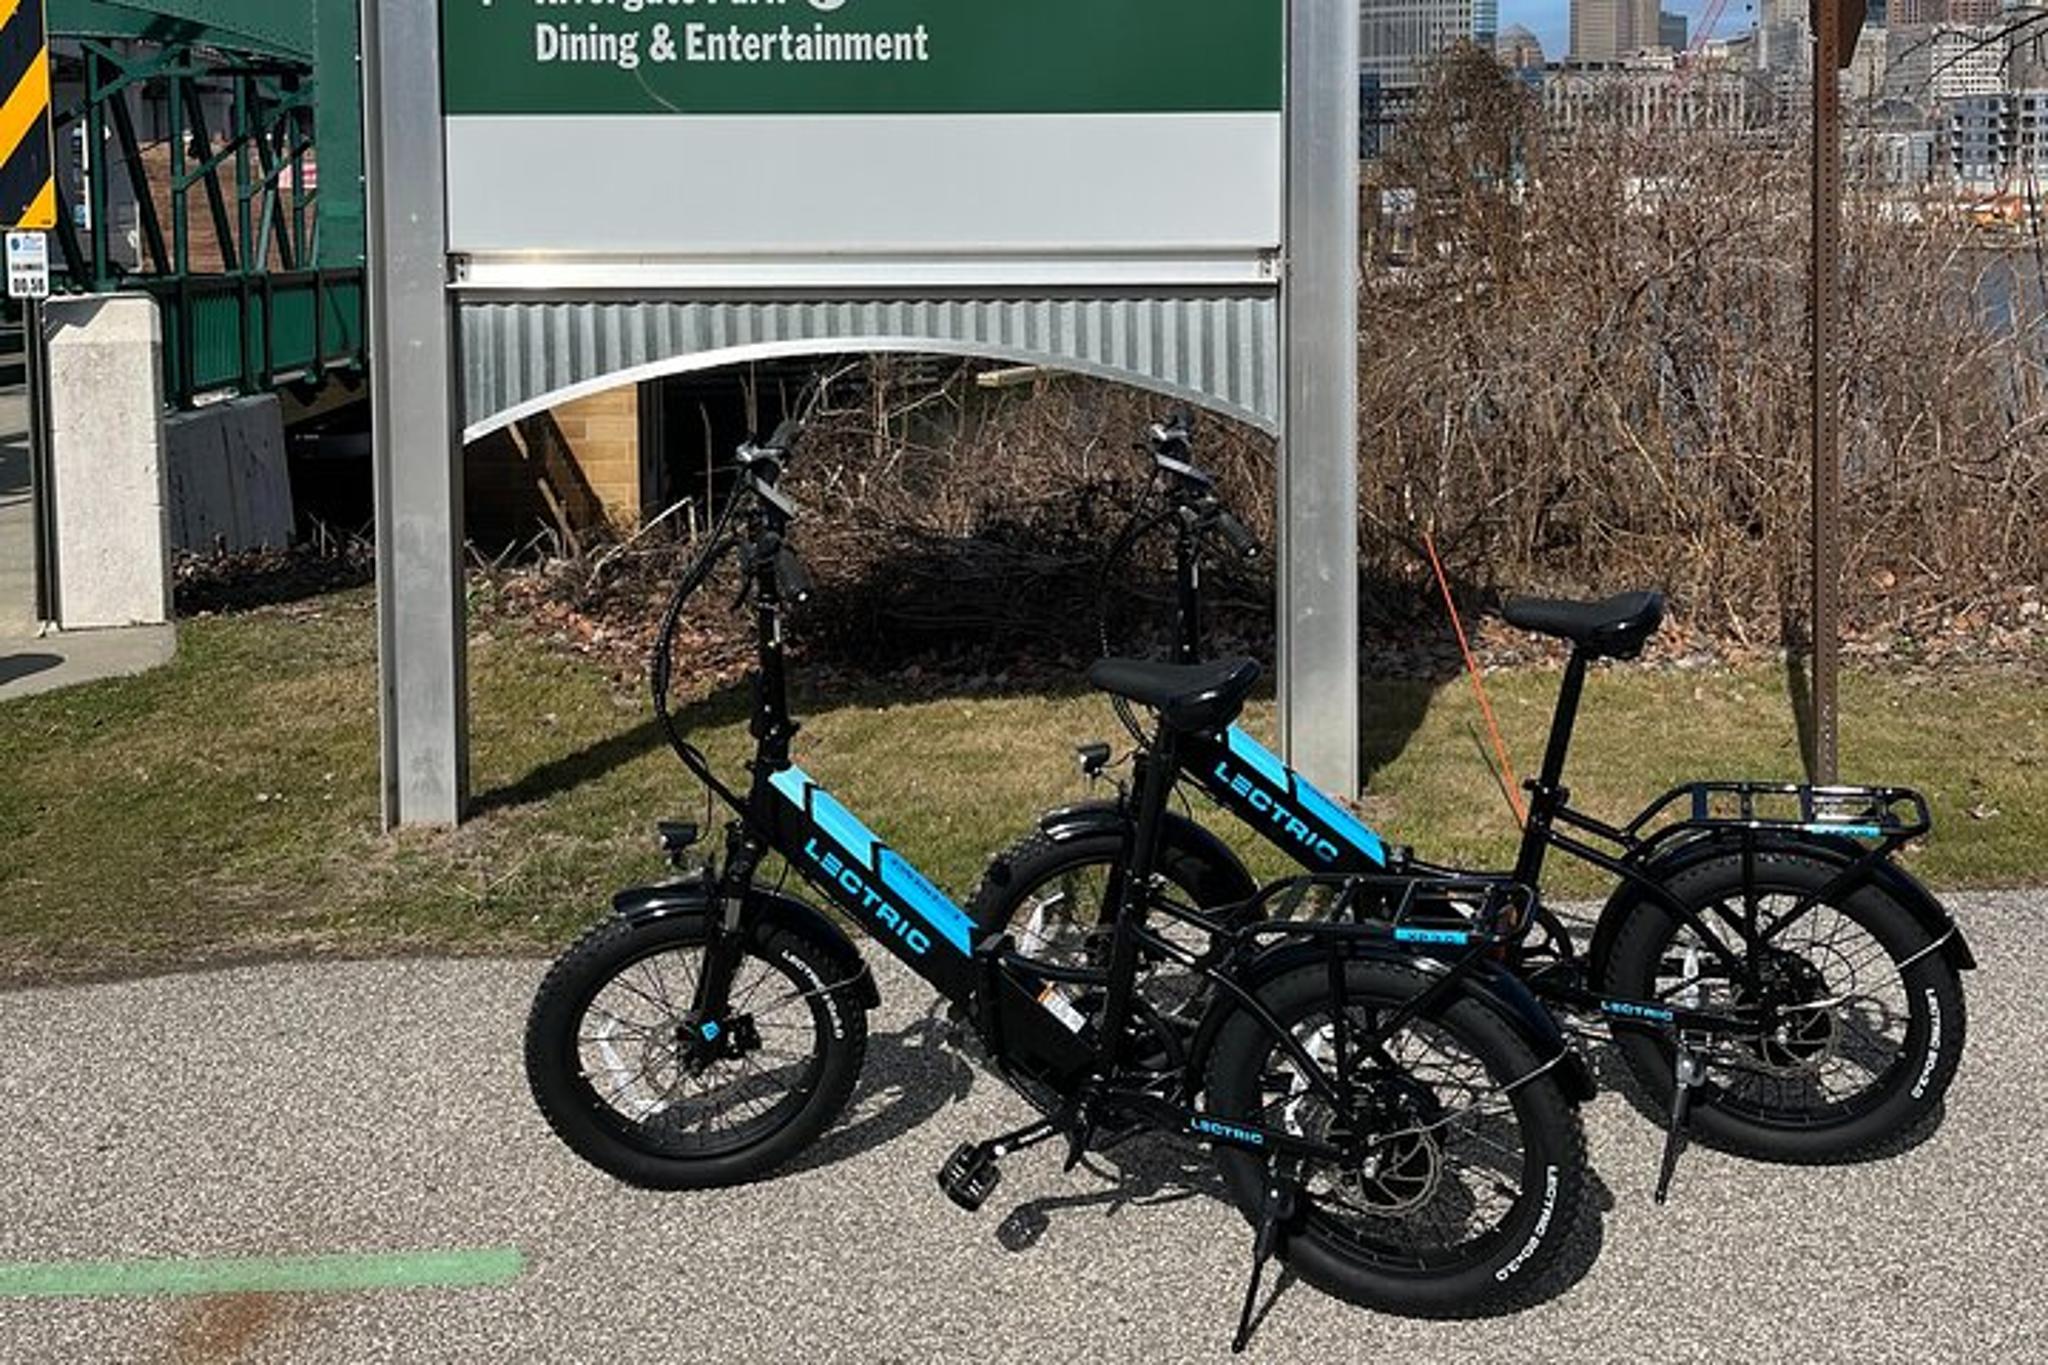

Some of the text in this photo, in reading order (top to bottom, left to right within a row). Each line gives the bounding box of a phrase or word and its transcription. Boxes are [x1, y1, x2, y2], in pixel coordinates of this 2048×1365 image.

[536, 22, 929, 69] Dining & Entertainment
[1214, 761, 1338, 863] LECTRIC
[804, 838, 931, 954] LECTRIC
[1601, 1000, 1673, 1020] LECTRIC
[1190, 1117, 1264, 1145] LECTRIC
[1535, 1165, 1559, 1237] LECTRIC
